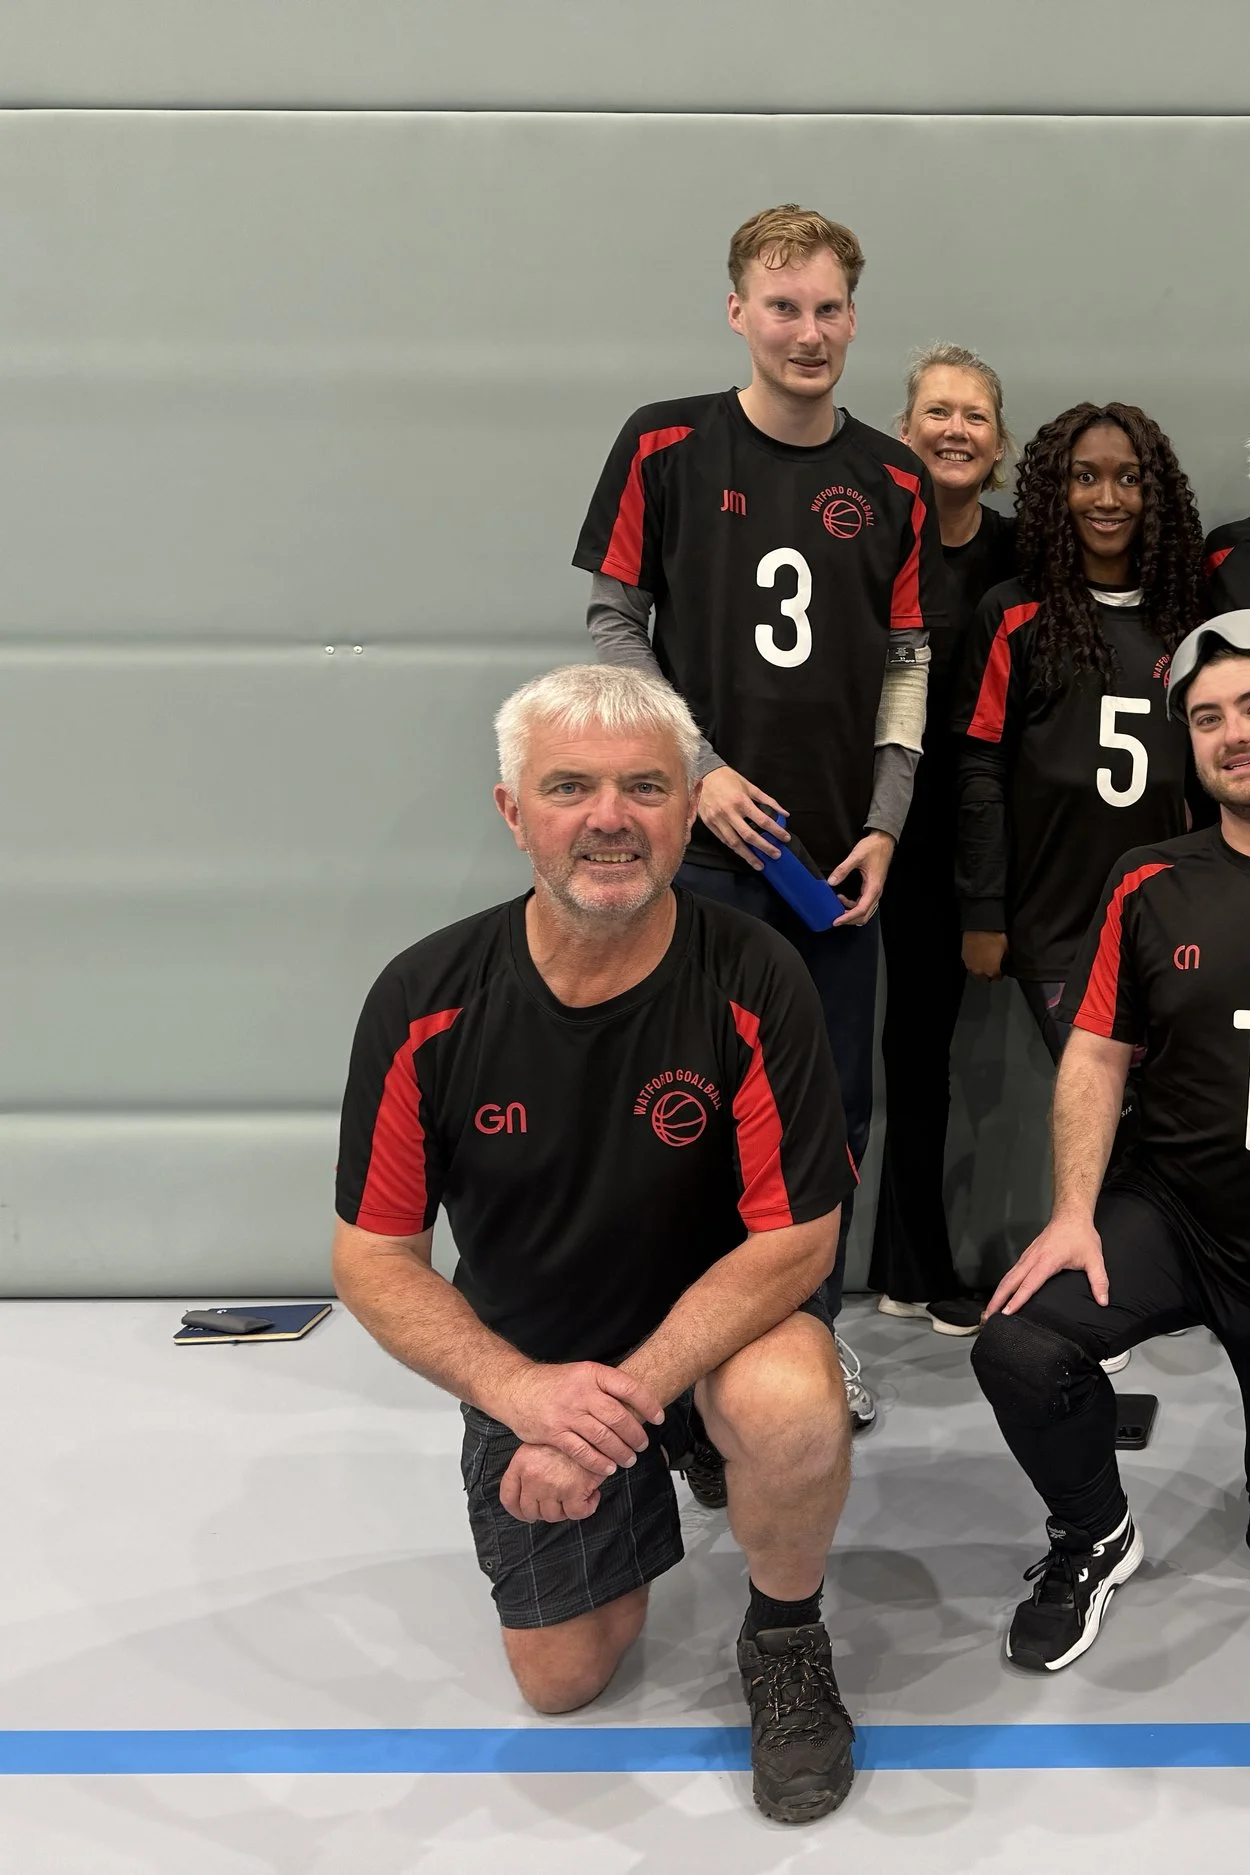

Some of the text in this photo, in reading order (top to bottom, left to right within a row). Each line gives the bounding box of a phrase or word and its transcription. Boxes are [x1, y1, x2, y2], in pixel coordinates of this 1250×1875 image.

[721, 490, 746, 516] JM
[811, 486, 875, 526] WATFORD GOALBALL
[755, 548, 812, 668] 3
[1097, 695, 1151, 807] 5
[634, 1069, 722, 1115] WATFORD GOALBALL
